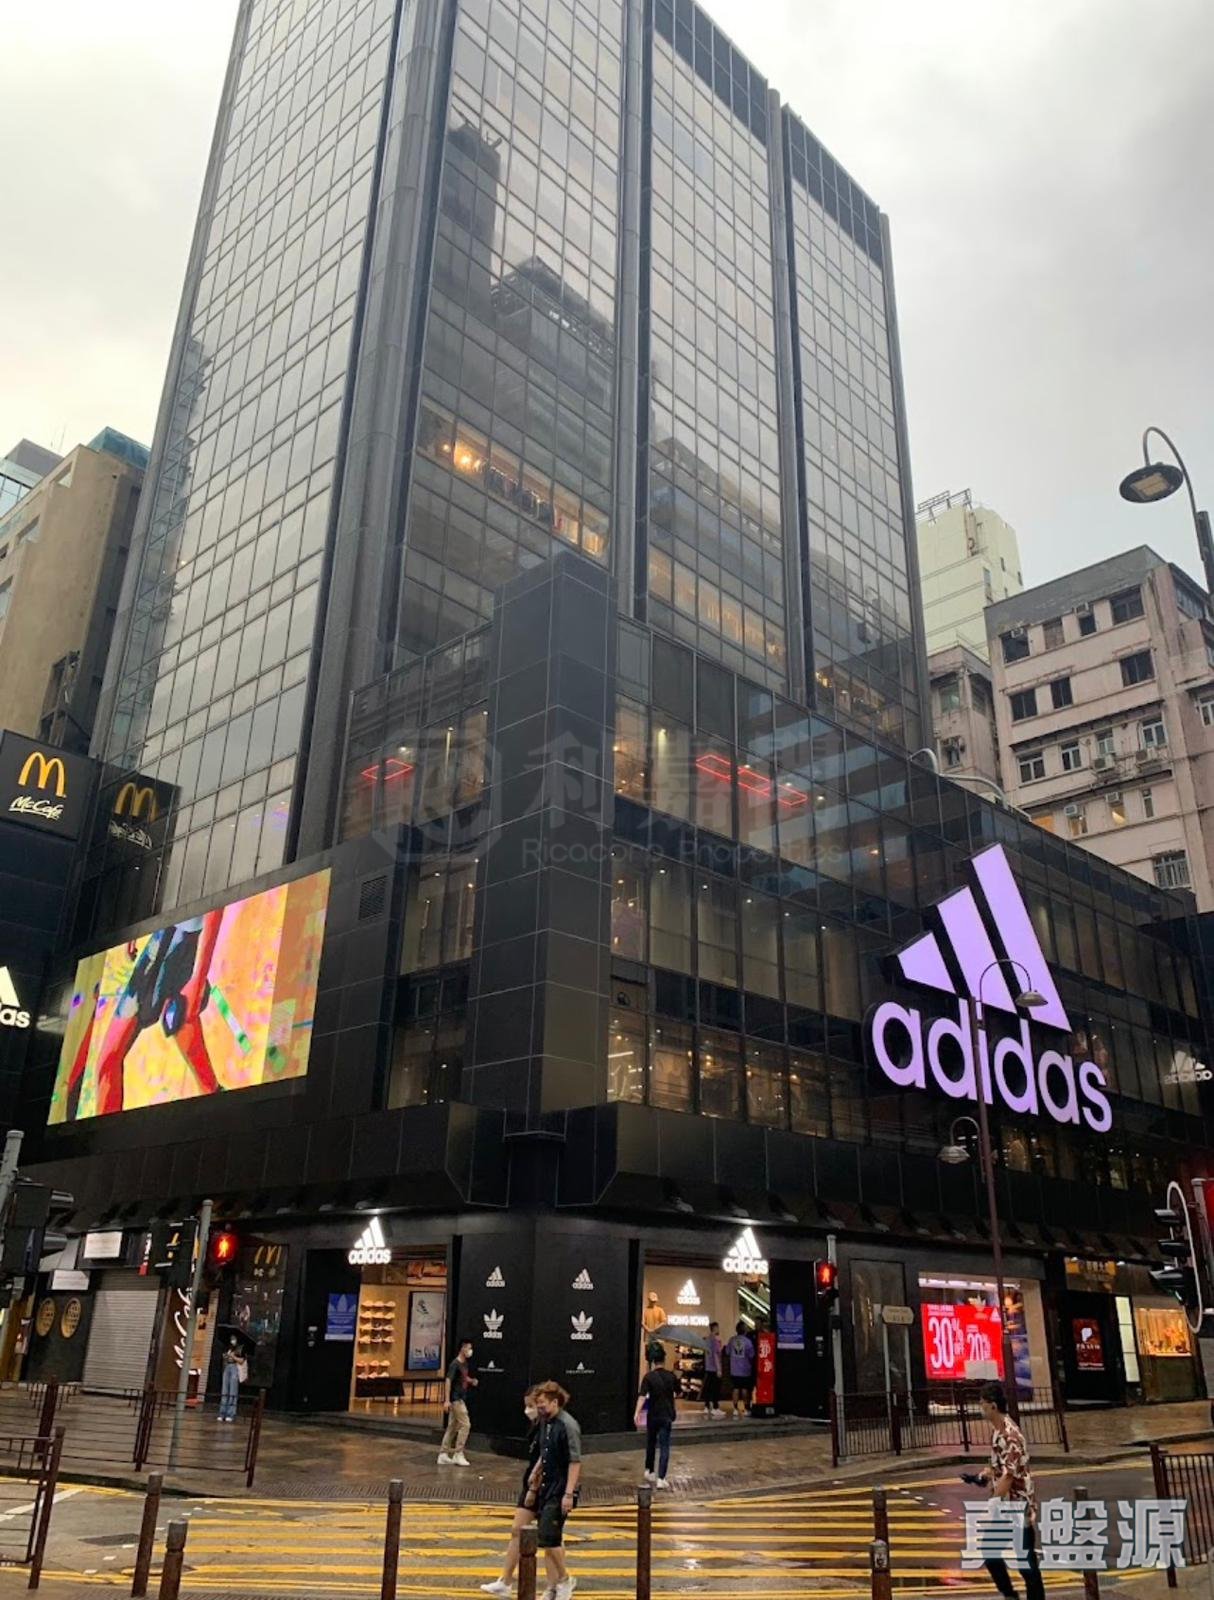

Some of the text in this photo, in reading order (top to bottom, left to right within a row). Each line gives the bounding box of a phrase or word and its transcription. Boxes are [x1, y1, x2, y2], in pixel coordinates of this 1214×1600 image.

[0, 1007, 31, 1029] as
[871, 996, 1113, 1133] adidas
[348, 1247, 392, 1265] adidas
[722, 1256, 769, 1275] adidas
[667, 1315, 689, 1326] HONG
